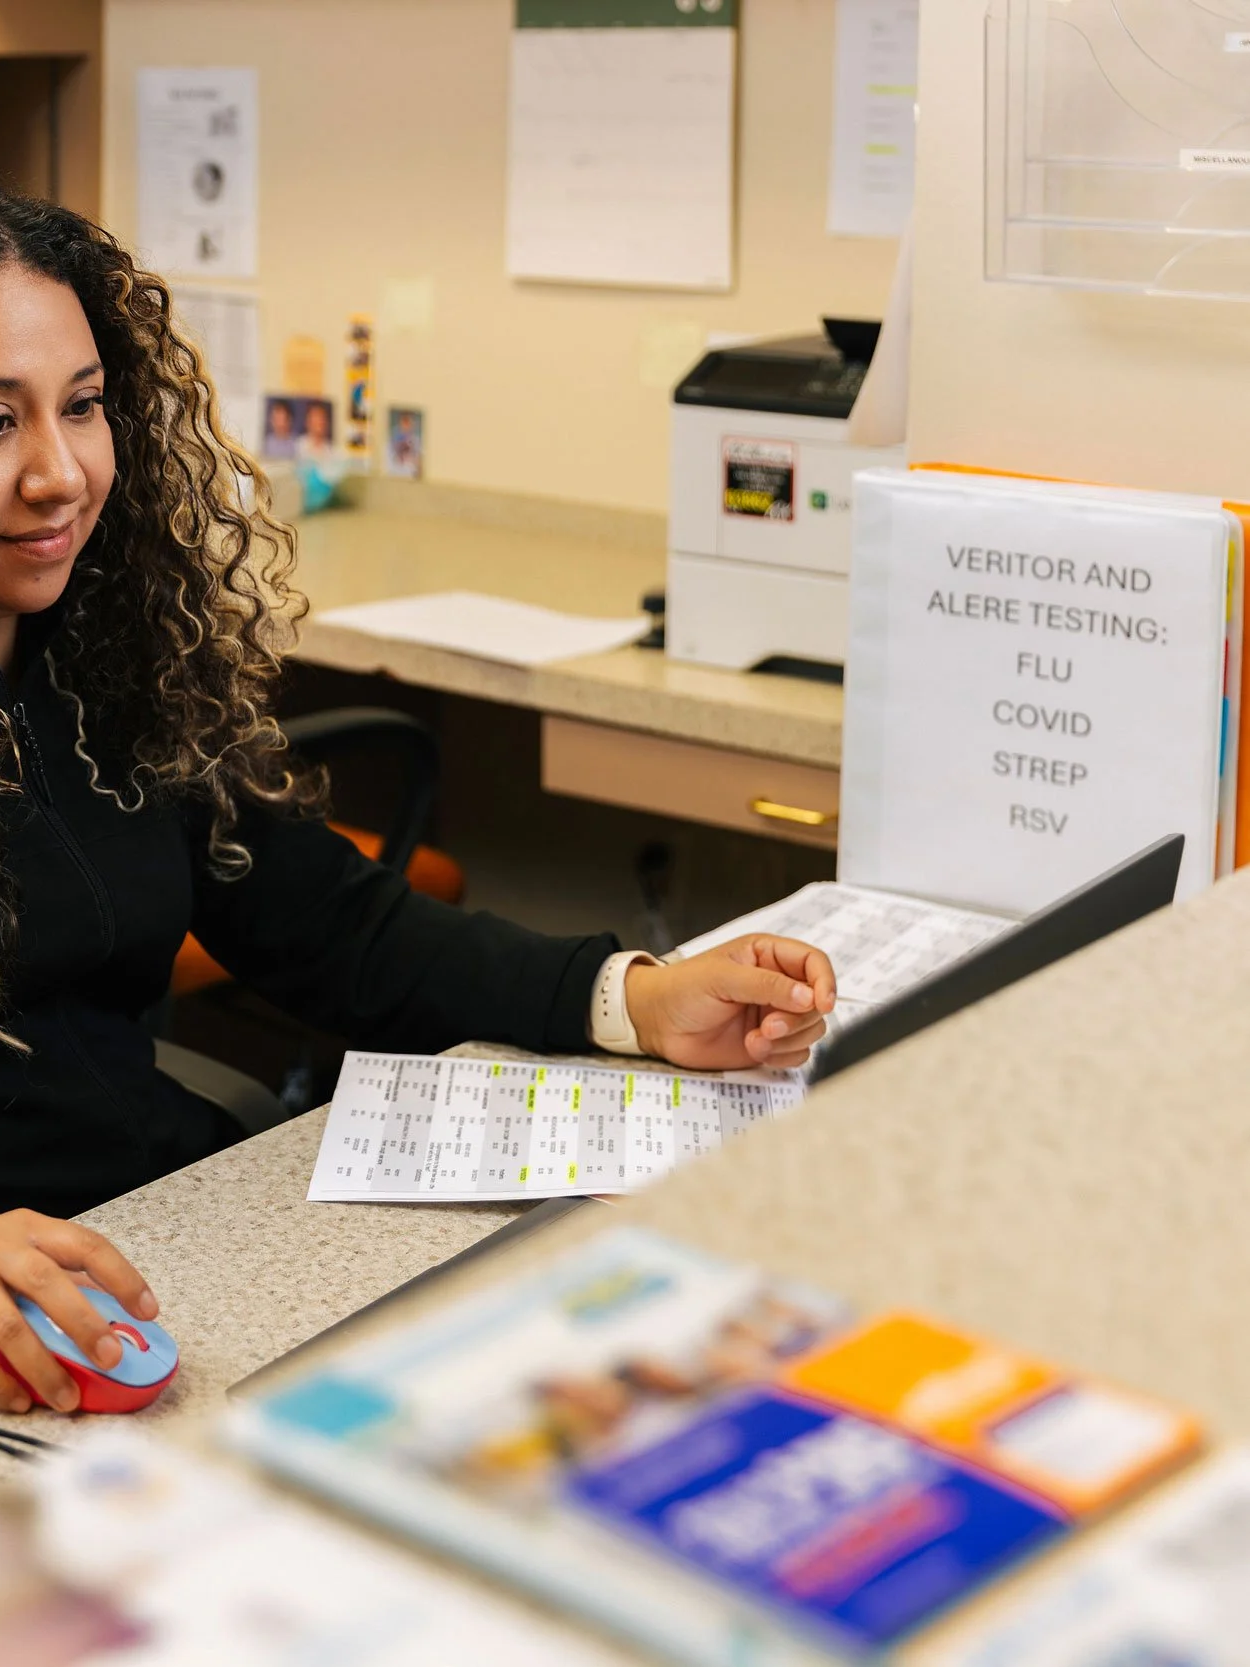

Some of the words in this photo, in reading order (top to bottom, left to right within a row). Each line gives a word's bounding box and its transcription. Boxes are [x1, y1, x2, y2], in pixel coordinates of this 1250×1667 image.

[946, 545, 1076, 584] VERITOR
[1084, 563, 1152, 594] AND
[926, 589, 1021, 625] ALERE
[1029, 601, 1168, 645] TESTING:
[1016, 652, 1073, 683] FLU
[992, 700, 1093, 738] COVID
[993, 750, 1089, 787] STREP
[1008, 804, 1069, 836] RSV
